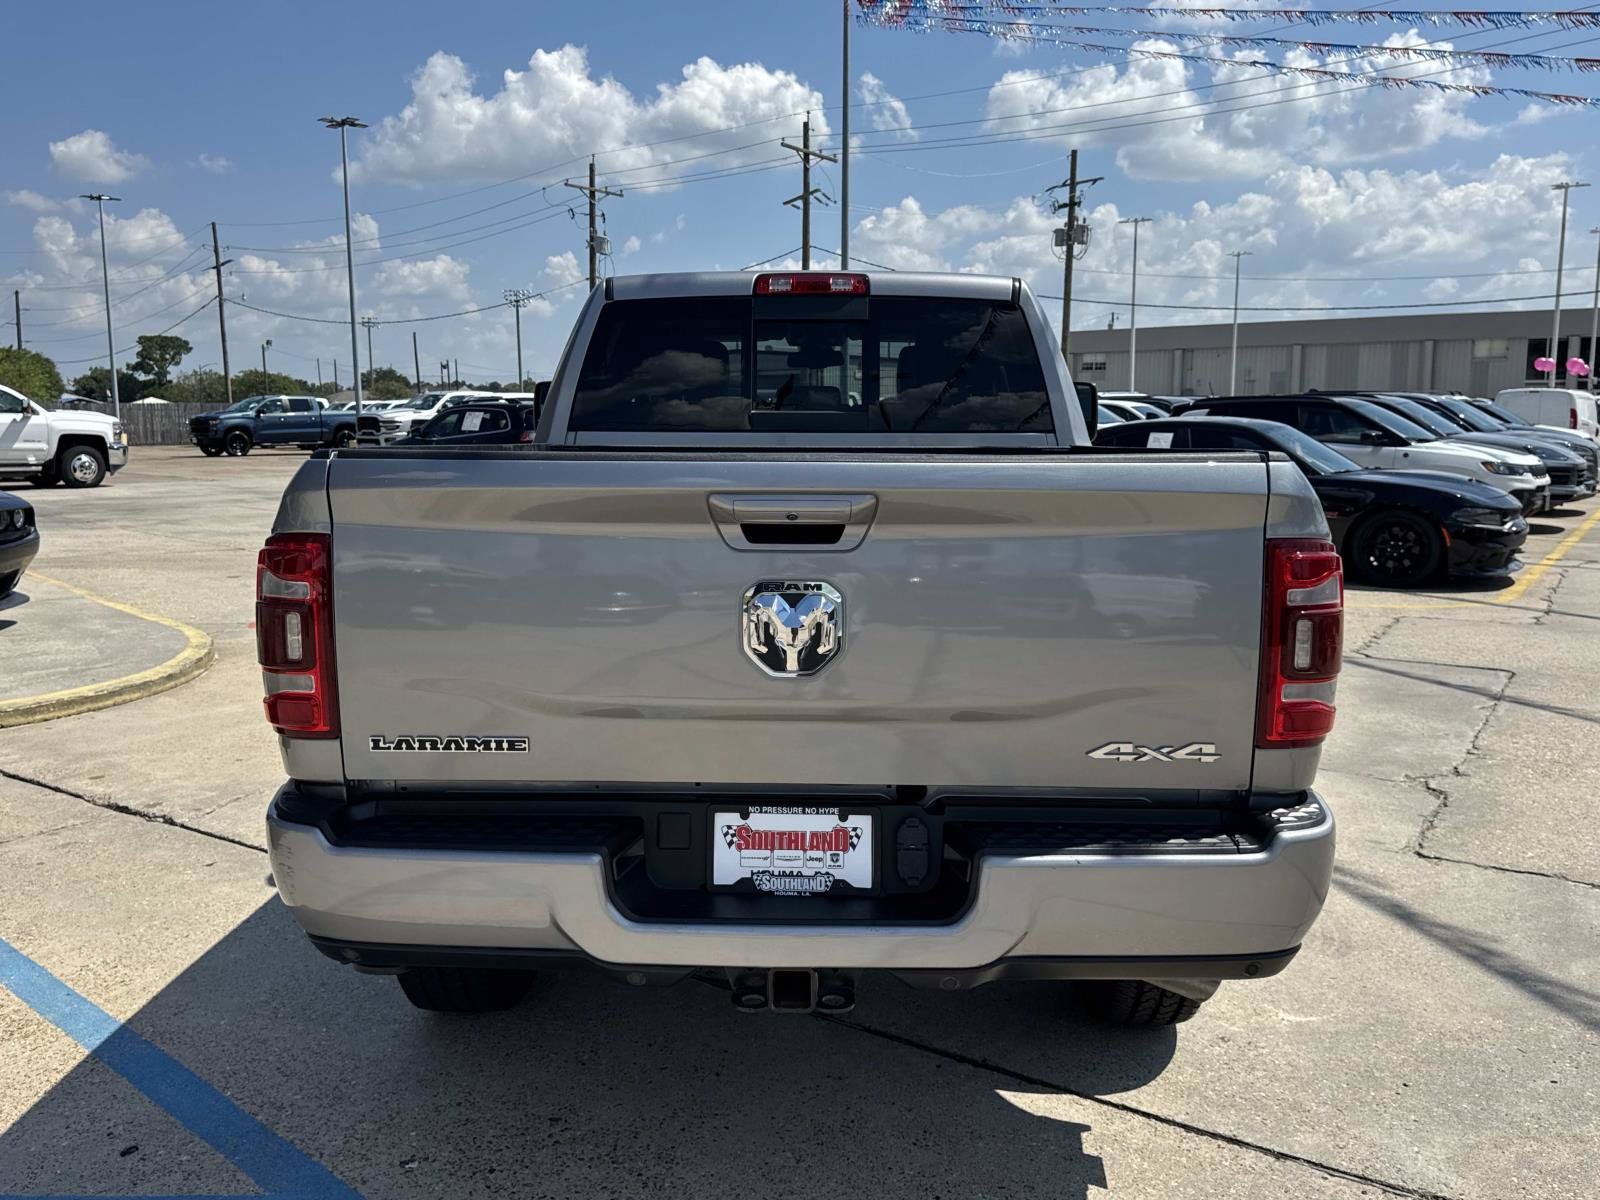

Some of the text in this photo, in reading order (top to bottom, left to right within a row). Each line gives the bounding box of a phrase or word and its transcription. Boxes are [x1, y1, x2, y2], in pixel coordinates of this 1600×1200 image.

[763, 583, 822, 592] RAM
[369, 735, 530, 752] LARAMIE
[762, 806, 803, 814] PRESSURE
[805, 807, 817, 815] NO
